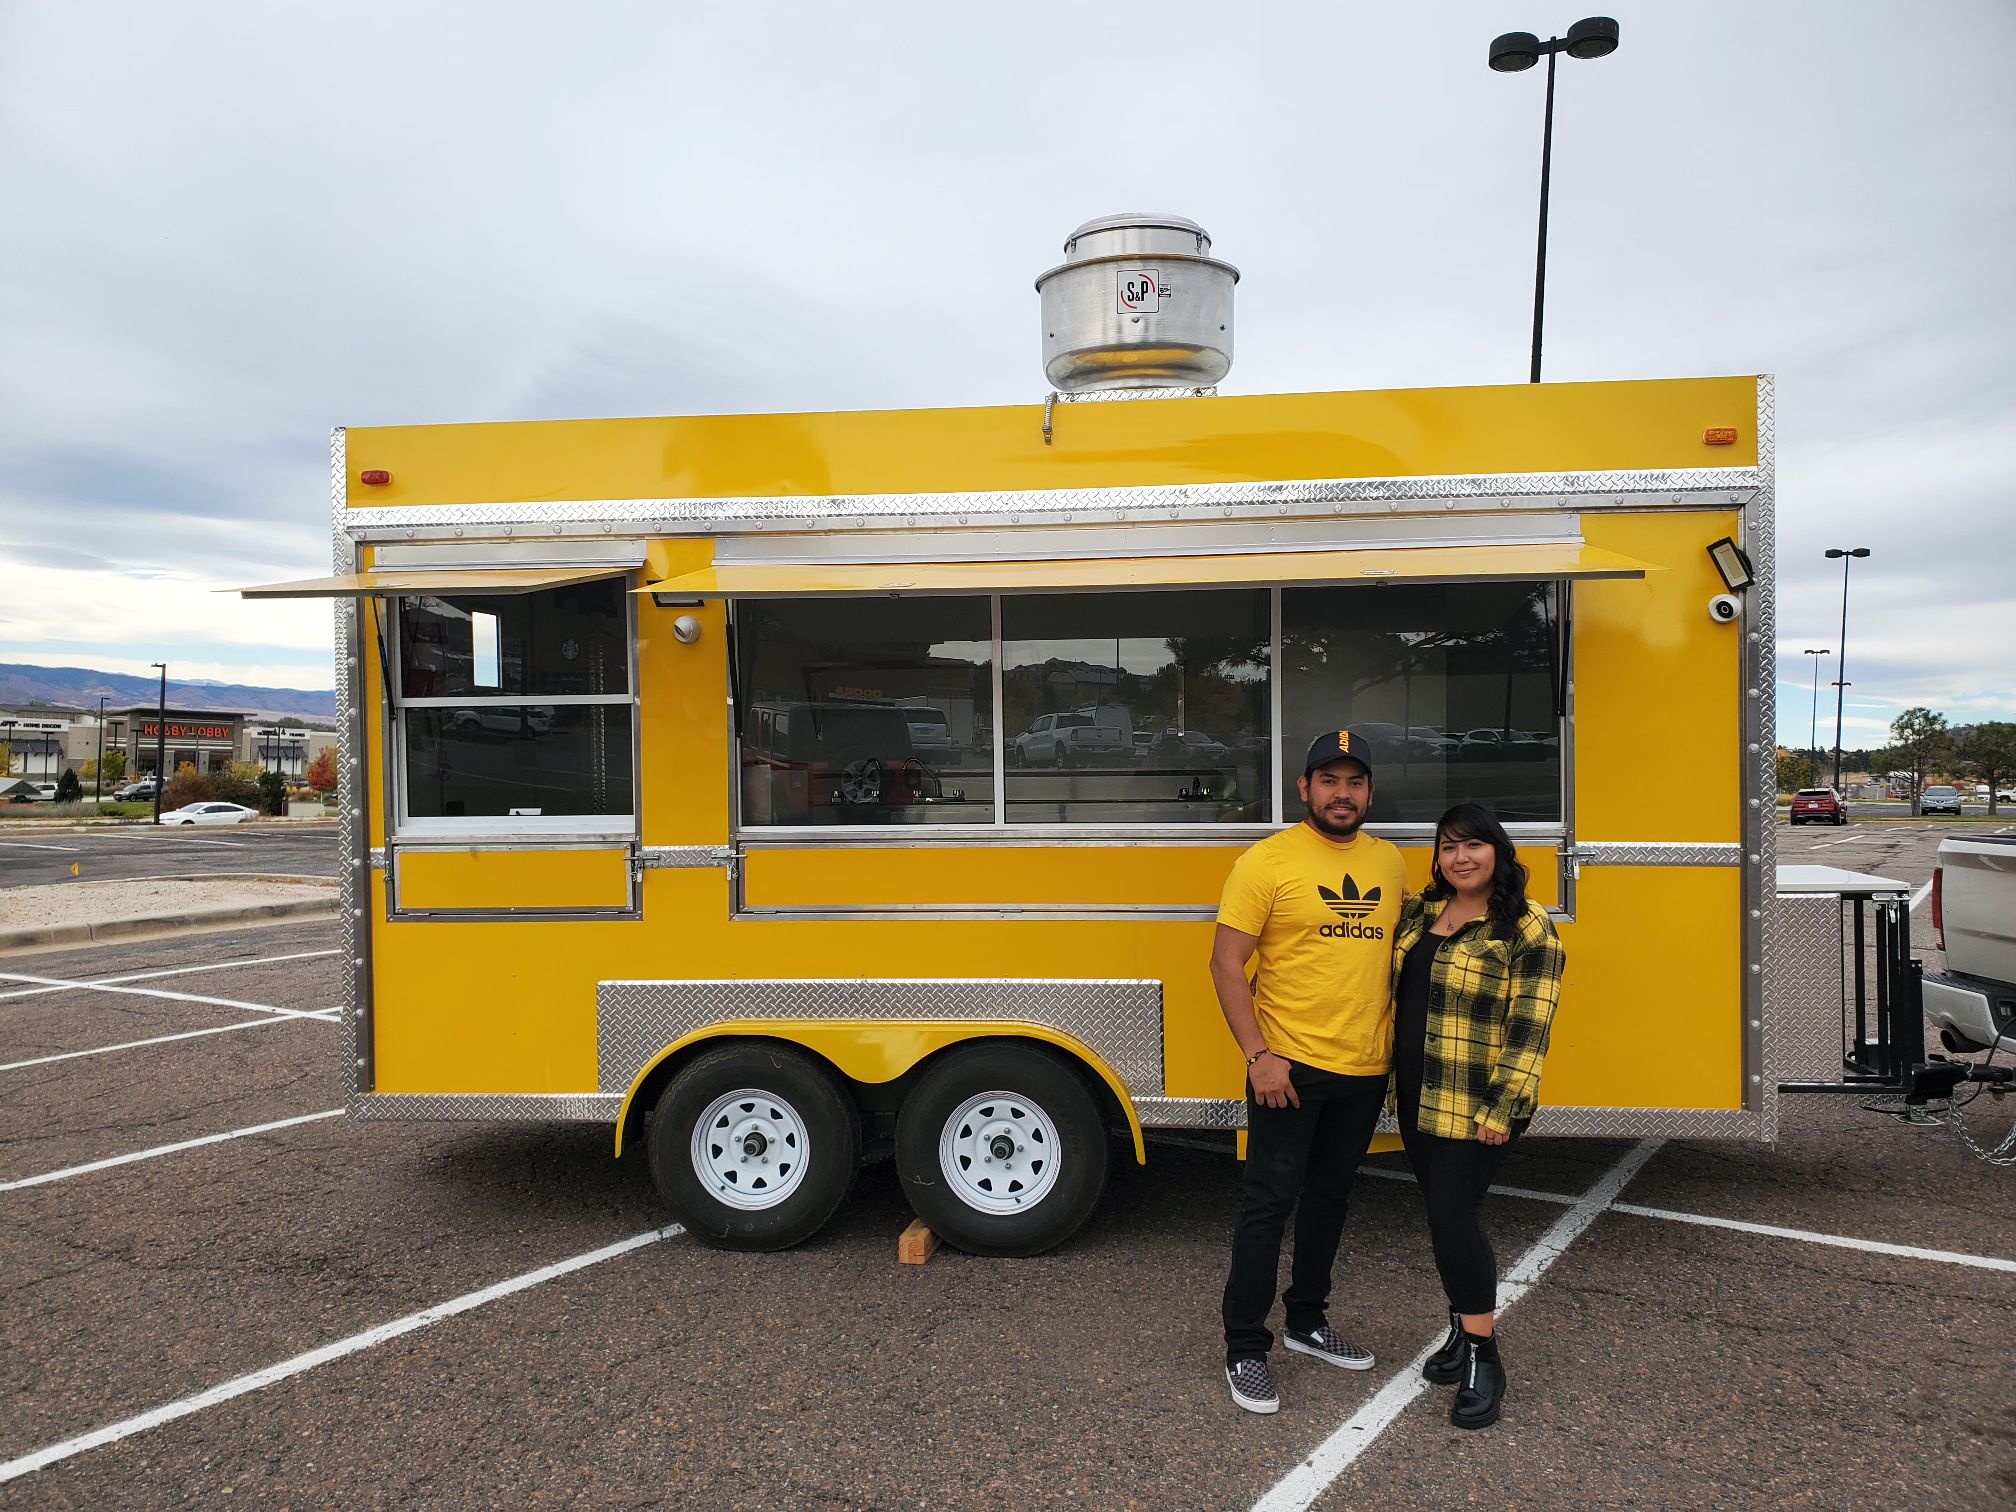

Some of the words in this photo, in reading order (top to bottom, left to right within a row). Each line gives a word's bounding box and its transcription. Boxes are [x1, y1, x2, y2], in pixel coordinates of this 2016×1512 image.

[1127, 281, 1149, 302] S&P
[191, 725, 229, 738] LOBBY
[1319, 921, 1384, 940] adidas
